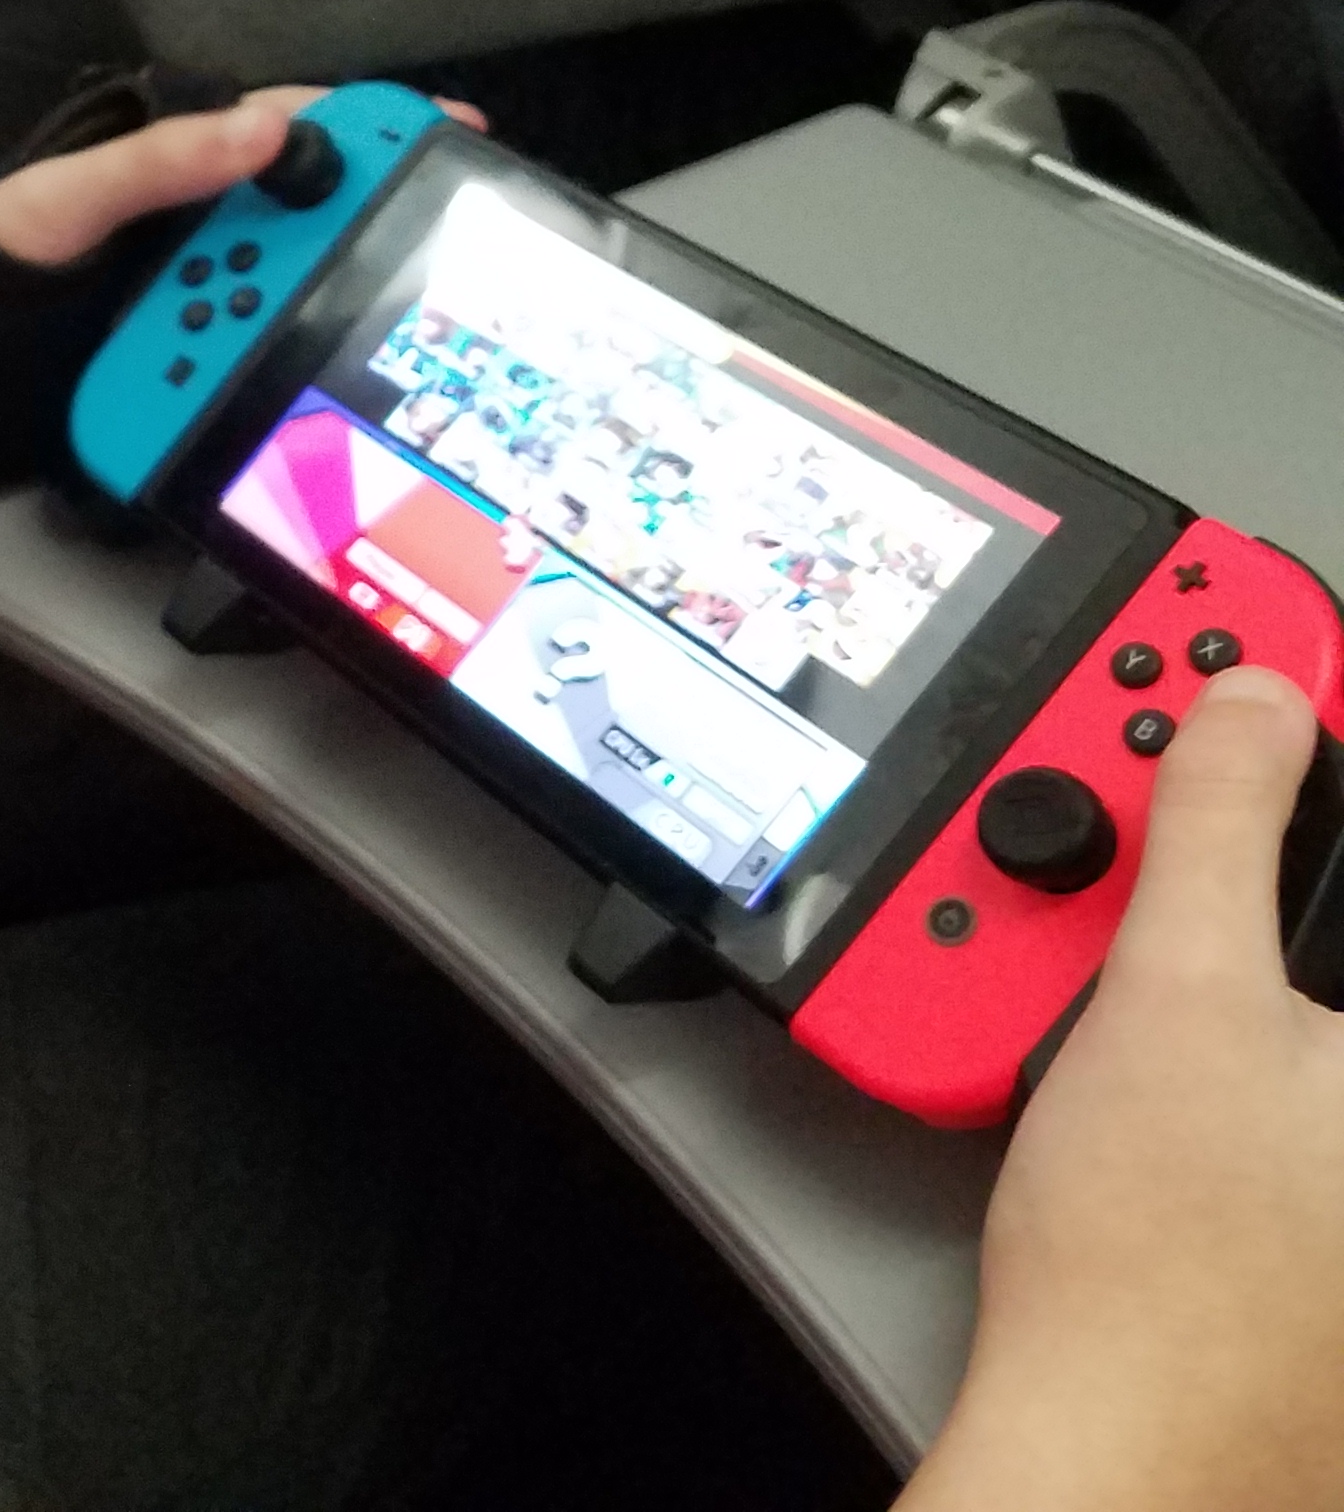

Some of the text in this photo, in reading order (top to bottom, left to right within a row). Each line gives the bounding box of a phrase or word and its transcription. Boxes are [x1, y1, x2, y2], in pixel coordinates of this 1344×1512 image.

[1125, 648, 1147, 670] Y
[1196, 636, 1224, 661] X
[1133, 718, 1158, 740] B
